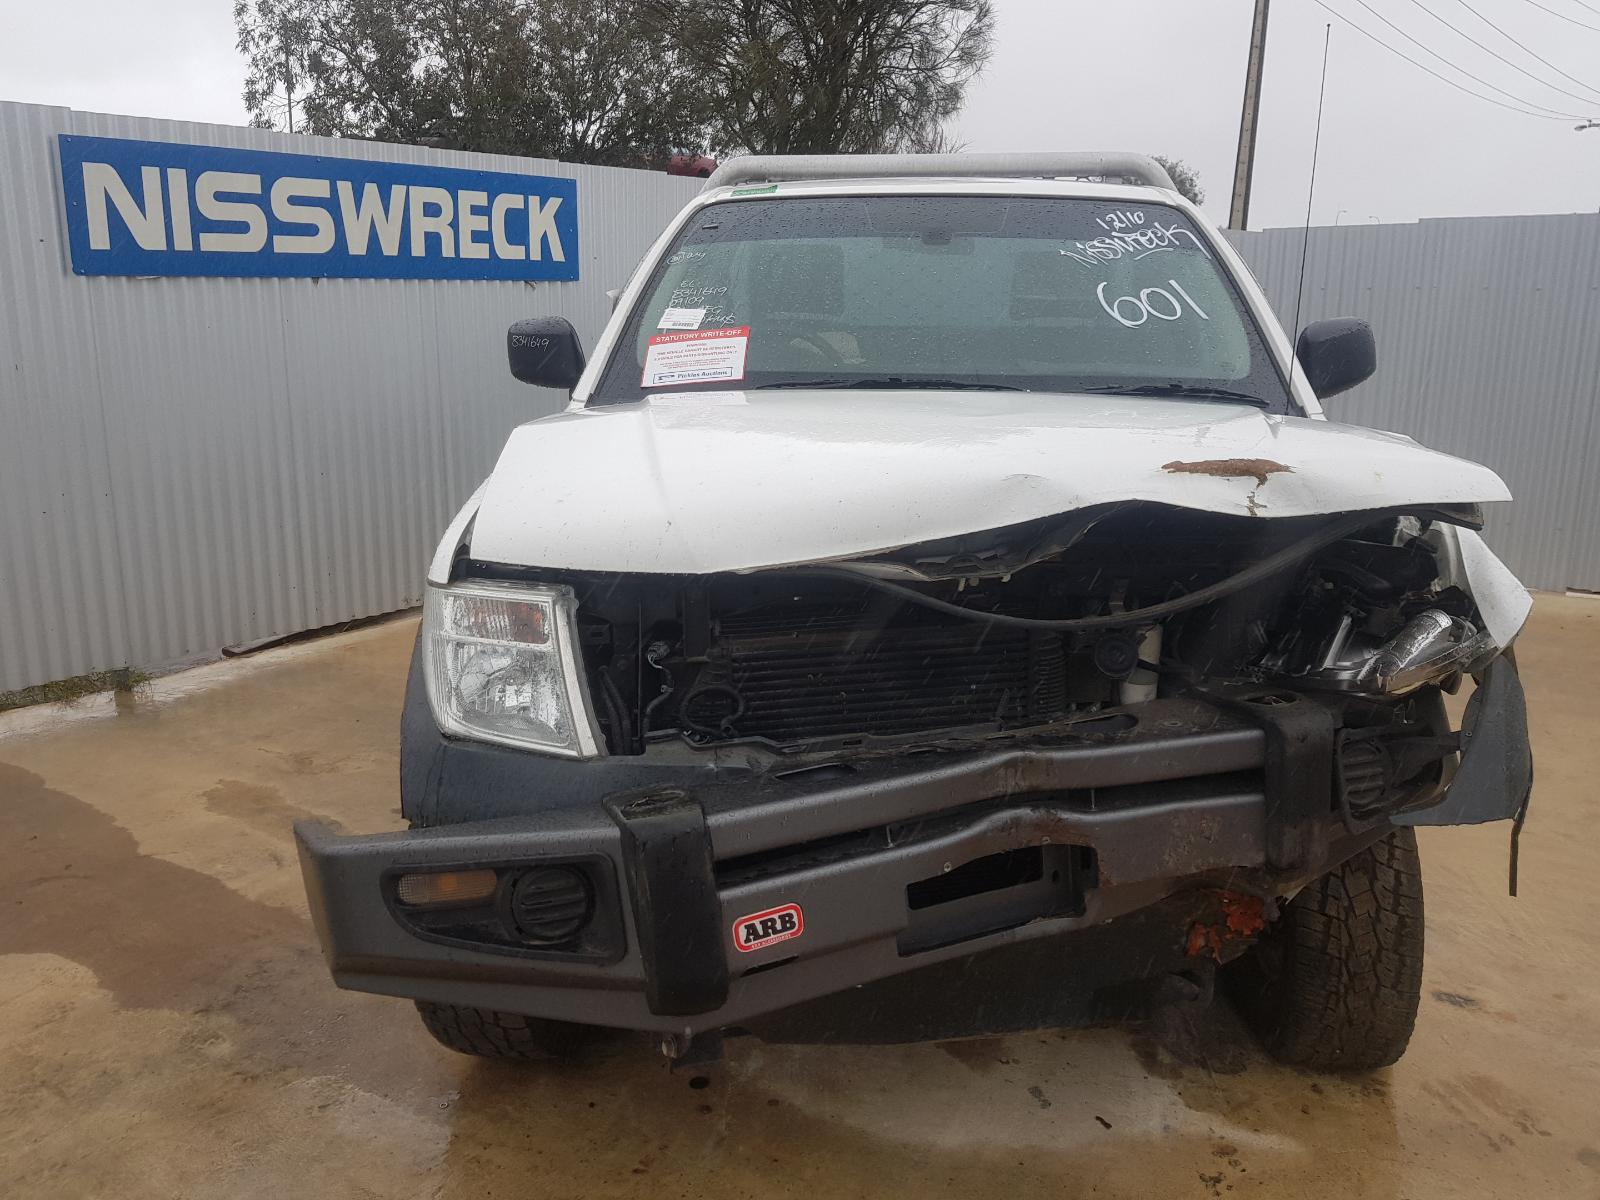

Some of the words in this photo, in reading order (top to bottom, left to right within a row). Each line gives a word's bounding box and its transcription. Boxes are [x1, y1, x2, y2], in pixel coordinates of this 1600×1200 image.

[81, 161, 566, 262] NISSWRECK
[1096, 279, 1209, 329] 601
[656, 333, 700, 343] STATUTORY
[700, 329, 742, 338] WRITE-OFF
[744, 912, 796, 944] ARB
